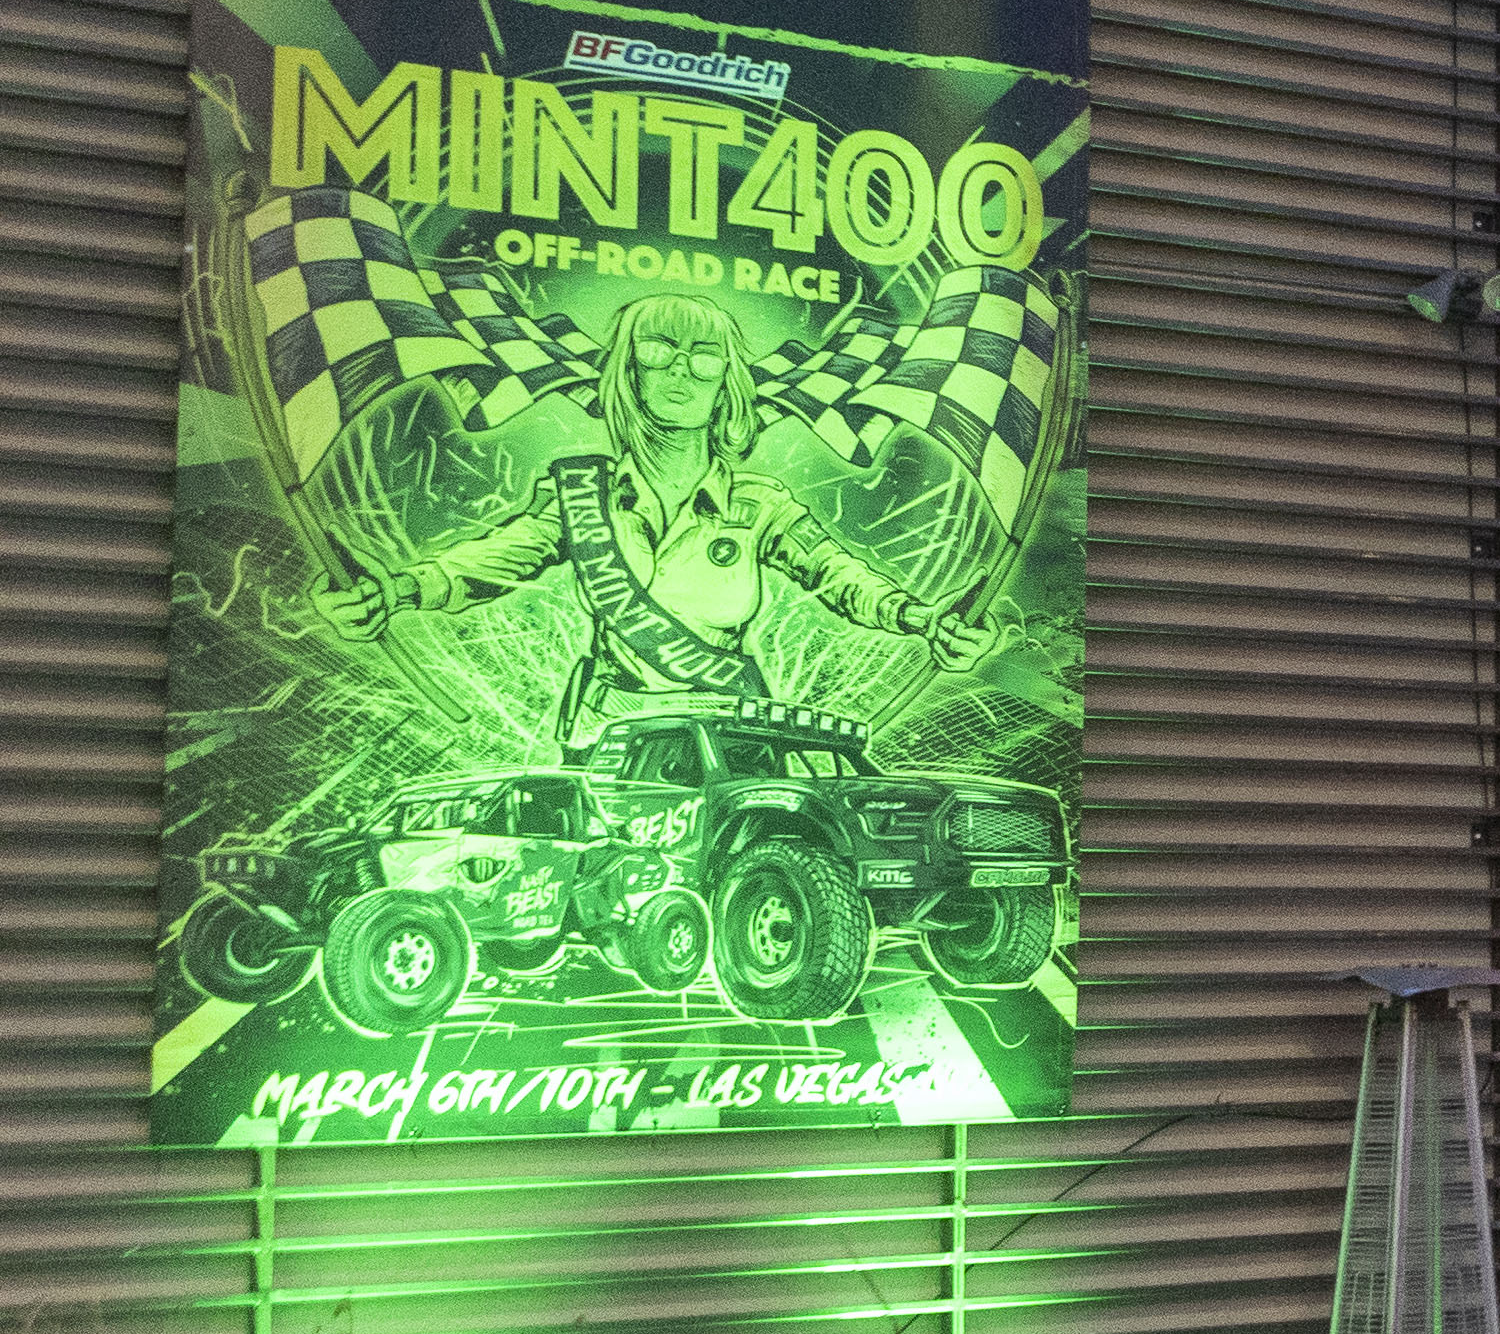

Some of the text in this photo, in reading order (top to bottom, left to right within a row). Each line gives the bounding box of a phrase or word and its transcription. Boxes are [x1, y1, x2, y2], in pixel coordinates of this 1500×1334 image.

[572, 34, 787, 88] BFGoodrich
[495, 227, 841, 304] OFF-ROAD RACE
[253, 1069, 418, 1123] MARCH
[432, 1065, 647, 1117] 6TH/10TH
[687, 1061, 764, 1107] LAS
